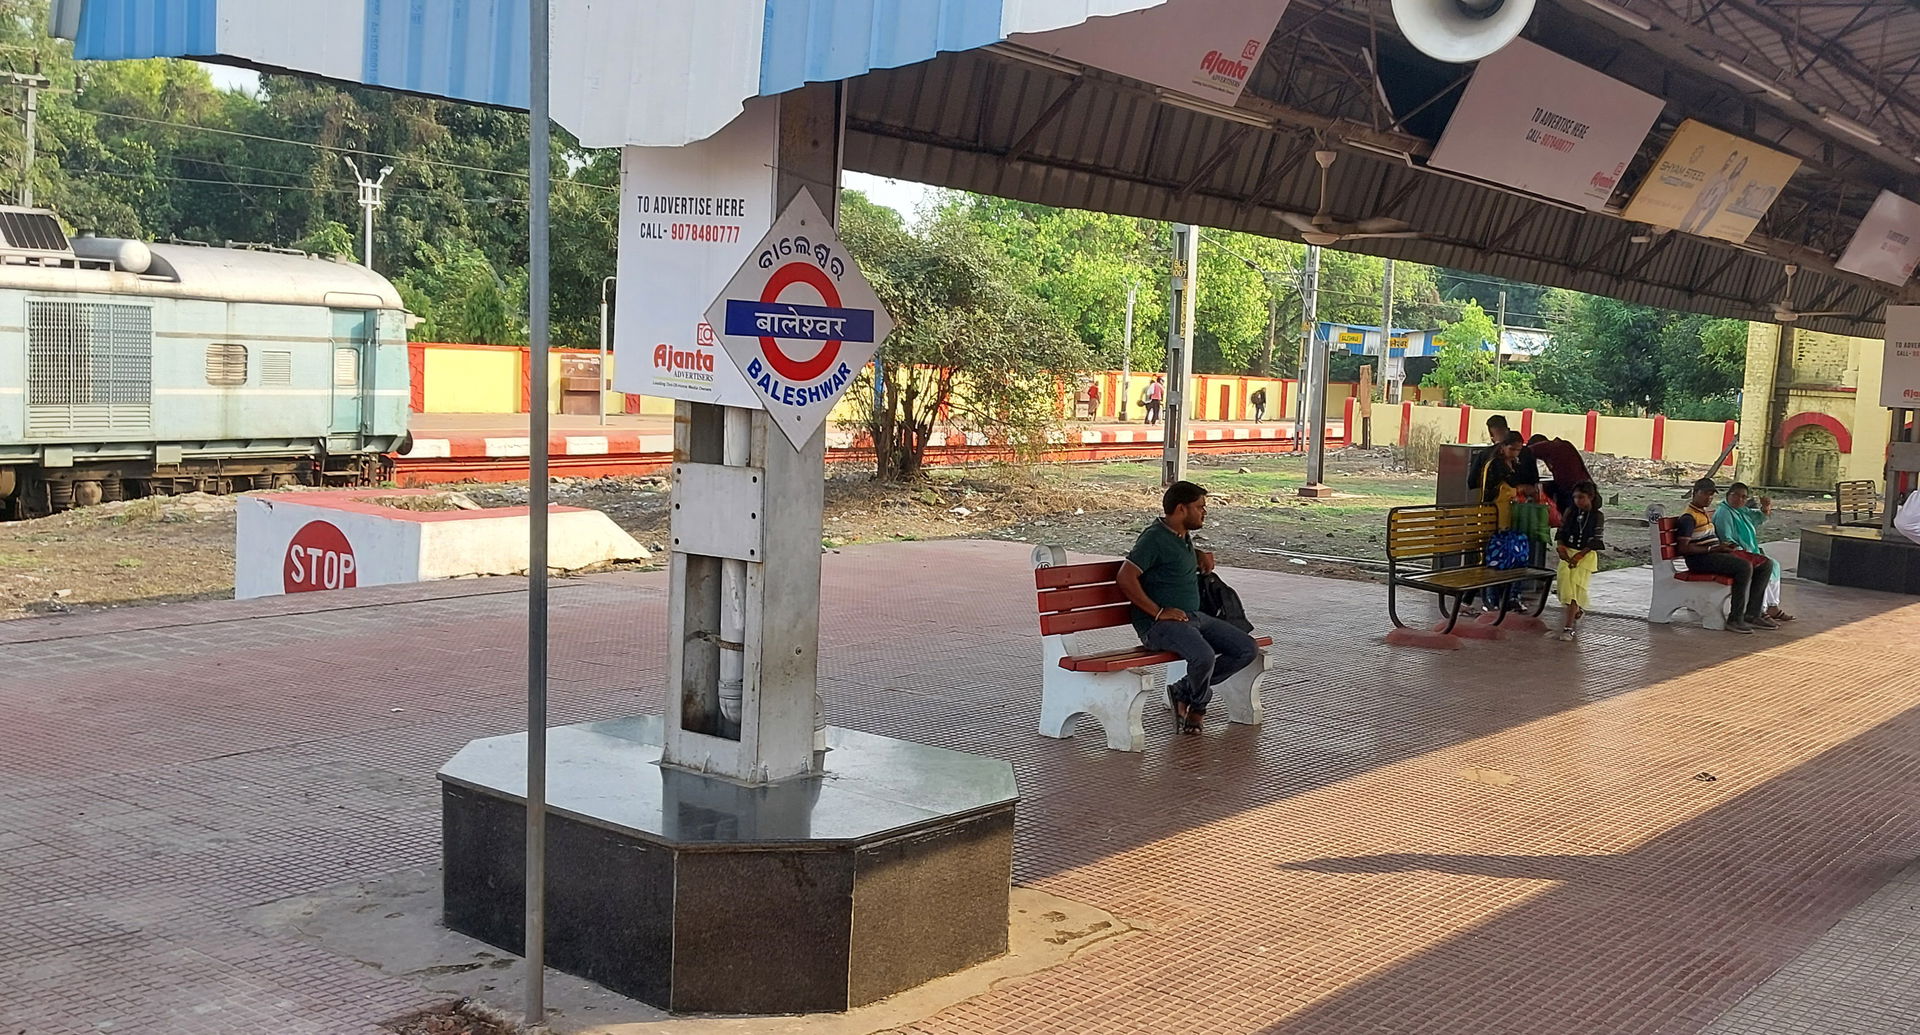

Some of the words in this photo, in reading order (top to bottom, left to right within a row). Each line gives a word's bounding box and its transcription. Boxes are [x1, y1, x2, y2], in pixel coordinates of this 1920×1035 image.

[1200, 50, 1249, 80] Ajanta
[1531, 107, 1543, 123] TO
[1540, 111, 1575, 134] ADVERTISE
[1570, 122, 1590, 139] HERE
[638, 196, 650, 213] TO
[653, 196, 712, 215] ADVERTISE
[716, 198, 745, 217] HERE
[640, 222, 667, 239] CALL-
[671, 223, 740, 243] 9078480777
[754, 306, 847, 338] बालेश्वर
[653, 344, 714, 373] Ajanta
[674, 370, 714, 382] ADVERTISERS
[747, 356, 852, 407] BALESHWAR
[1903, 389, 1920, 399] Aja
[290, 544, 355, 590] STOP
